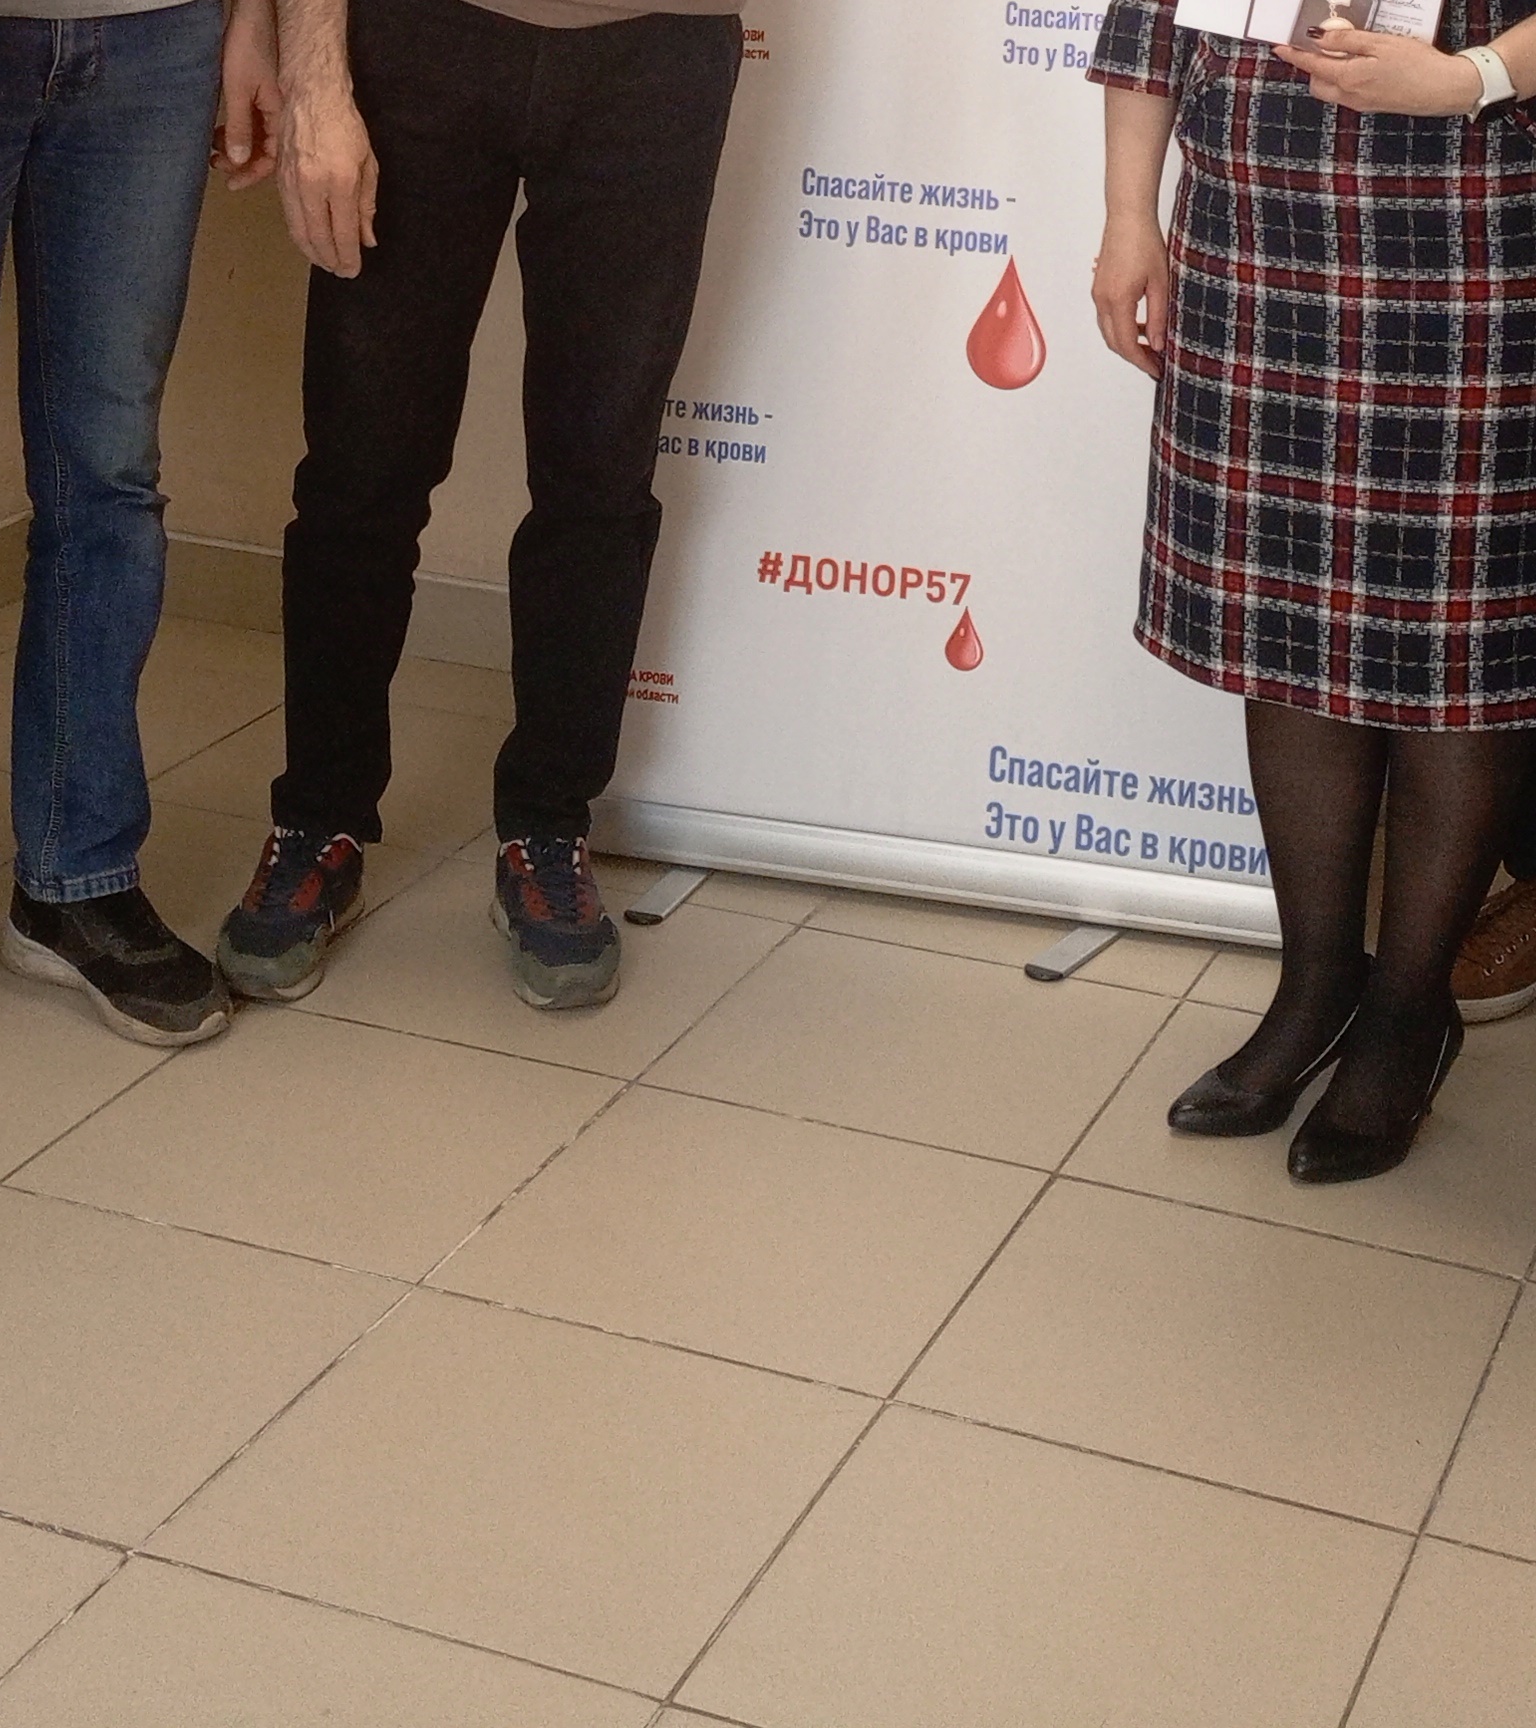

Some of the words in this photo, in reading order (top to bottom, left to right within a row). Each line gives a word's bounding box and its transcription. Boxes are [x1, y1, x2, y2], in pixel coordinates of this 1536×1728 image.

[1005, 1, 1105, 32] Спасайте
[744, 29, 764, 42] ОВИ
[744, 49, 769, 60] асти
[1003, 39, 1039, 66] Это
[1045, 45, 1058, 71] у
[801, 166, 913, 204] Спасайте
[919, 183, 999, 211] жизнь
[799, 210, 839, 240] Это
[846, 219, 860, 247] у
[865, 215, 907, 246] Вас
[914, 226, 928, 247] в
[935, 228, 1008, 256] крови
[692, 400, 760, 425] жизнь
[659, 434, 682, 455] ас
[687, 436, 699, 456] в
[705, 439, 767, 464] крови
[757, 551, 972, 606] #ДОНОР57
[639, 670, 674, 686] КРОВИ
[636, 688, 678, 704] области
[989, 745, 1139, 800] Спасайте
[1147, 774, 1257, 816] жизнь
[985, 801, 1039, 844] Это
[1048, 819, 1066, 855] у
[1075, 813, 1131, 857] Вас
[1141, 832, 1159, 860] в
[1169, 835, 1267, 877] крови
